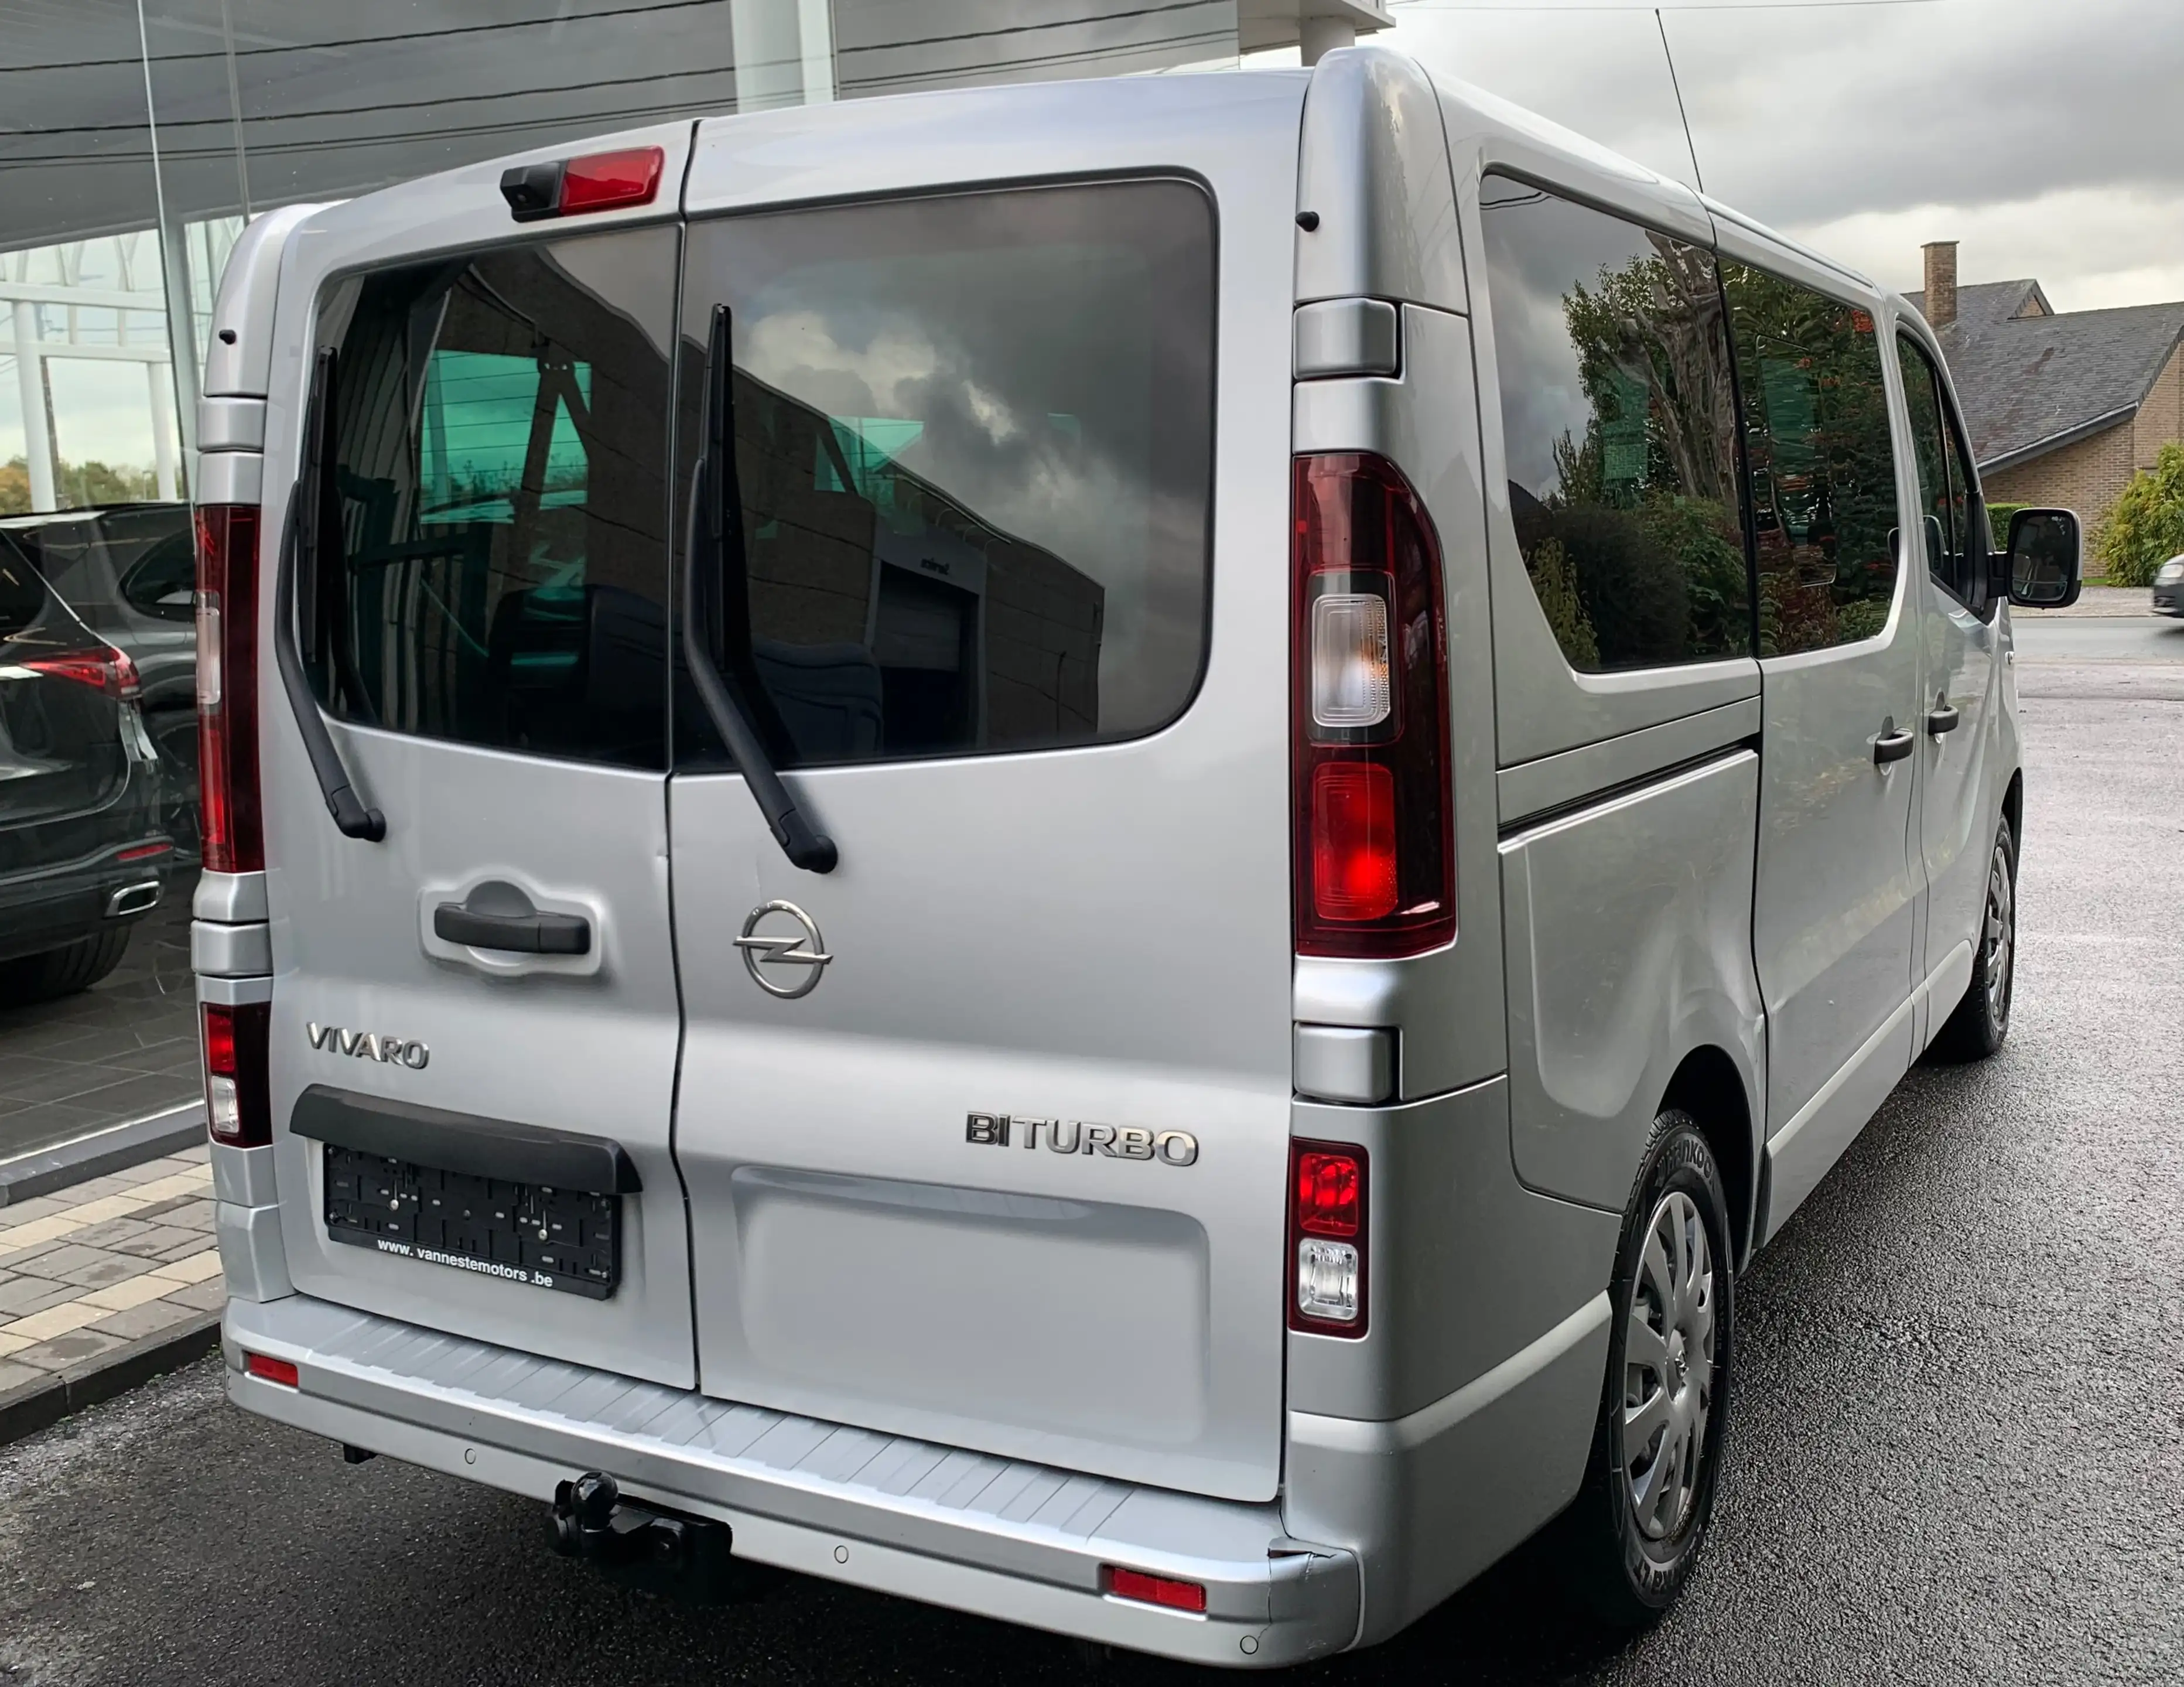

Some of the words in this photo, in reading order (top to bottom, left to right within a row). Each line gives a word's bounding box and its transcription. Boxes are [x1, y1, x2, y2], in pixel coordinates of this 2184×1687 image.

[306, 1022, 429, 1069] VIVARO
[966, 1111, 1199, 1166] BITURBO
[378, 1239, 413, 1256] www.
[416, 1248, 527, 1281] vannestemotors
[531, 1271, 552, 1287] .be
